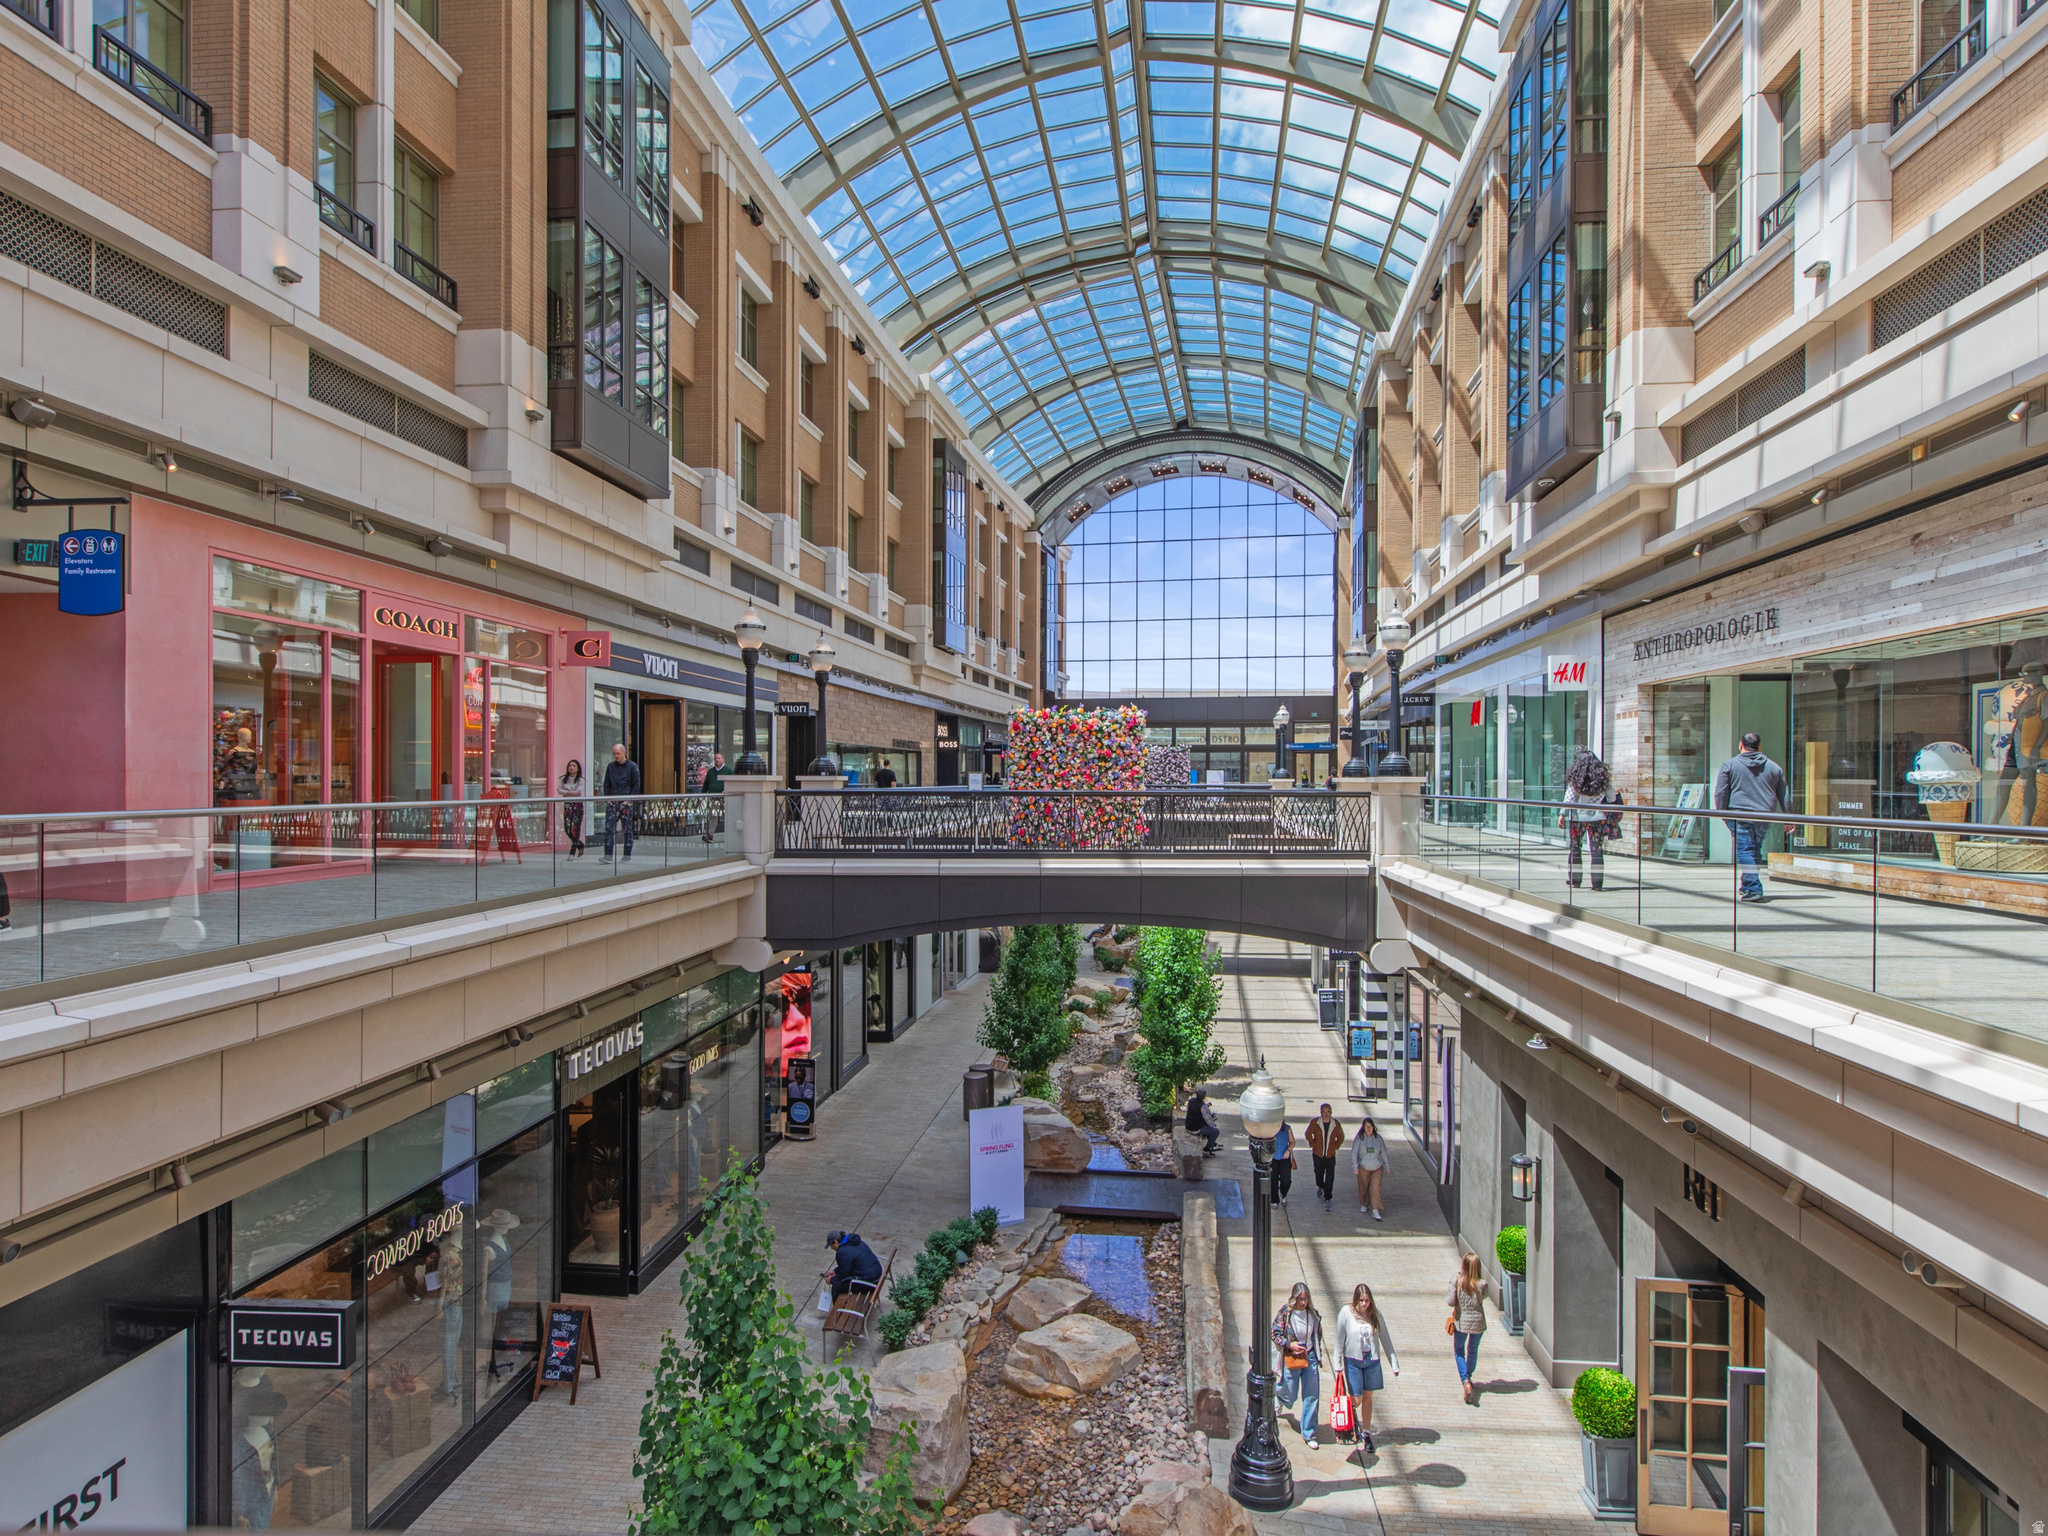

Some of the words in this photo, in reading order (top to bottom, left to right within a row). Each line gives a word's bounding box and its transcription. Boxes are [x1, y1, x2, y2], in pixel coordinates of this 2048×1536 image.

[25, 543, 48, 562] EXIT
[64, 567, 84, 576] Family
[374, 607, 459, 639] COACH
[1633, 607, 1777, 662] ANTHROPOLOGIE
[574, 638, 602, 659] C
[643, 653, 679, 680] vuori
[1553, 662, 1586, 684] H&M
[780, 705, 807, 713] vuori
[1838, 801, 1863, 810] SUMMER
[1838, 828, 1851, 837] ONE
[1853, 829, 1862, 837] OF
[565, 1022, 644, 1080] TECOVAS
[979, 1144, 999, 1153] SPRING
[999, 1142, 1014, 1151] FLING
[367, 1226, 425, 1281] COWBOY
[426, 1201, 464, 1243] BOOTS
[238, 1328, 333, 1348] TECOVAS
[16, 1457, 127, 1535] IRST
